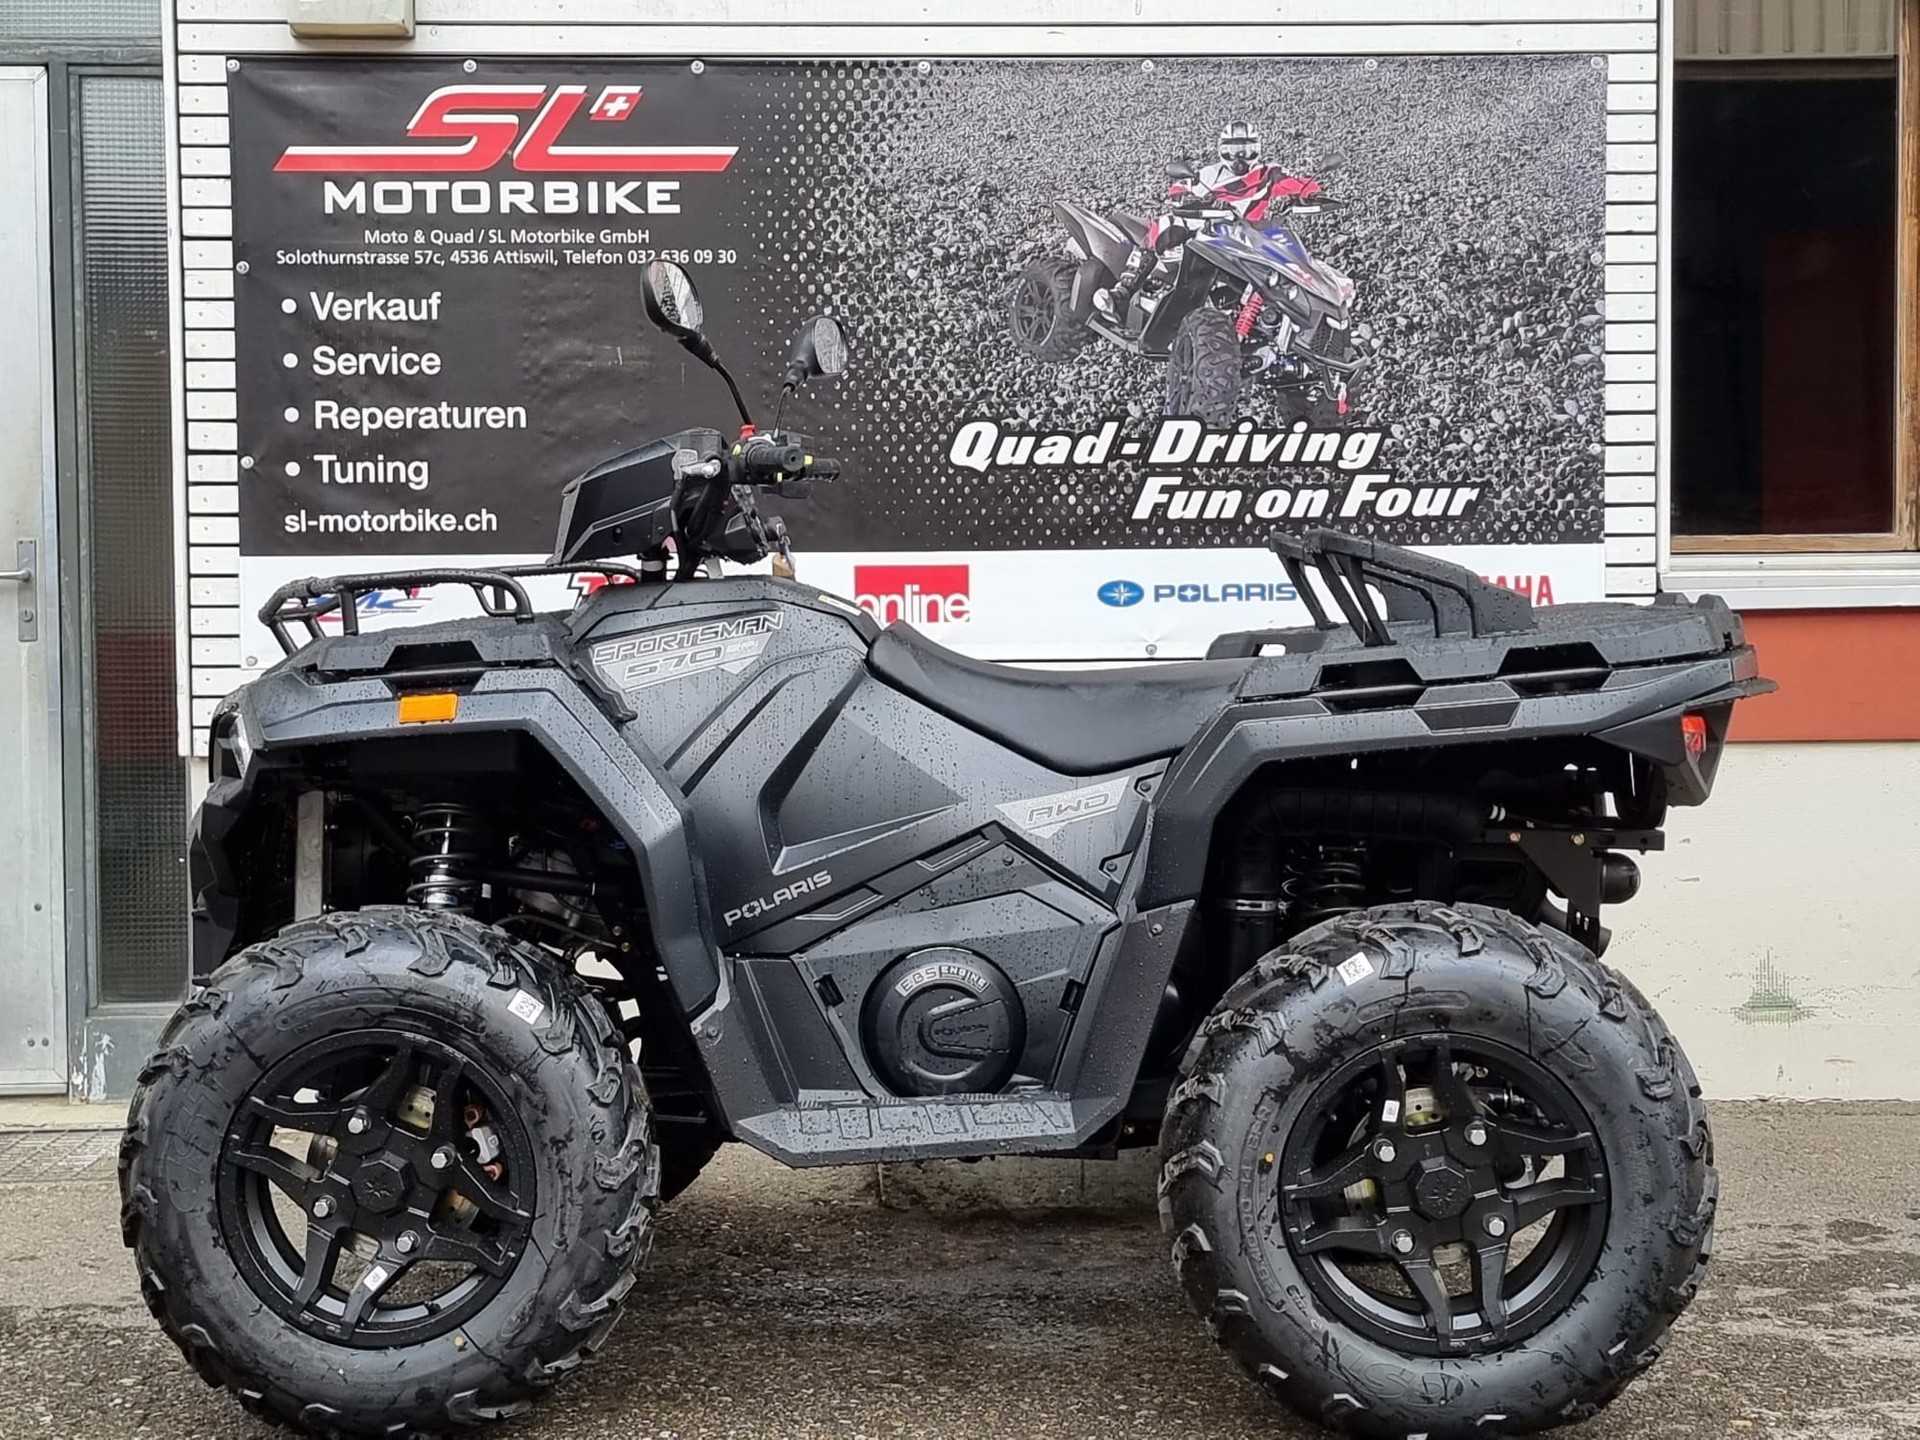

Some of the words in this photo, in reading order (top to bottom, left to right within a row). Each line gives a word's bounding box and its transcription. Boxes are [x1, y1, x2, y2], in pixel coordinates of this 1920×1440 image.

[323, 180, 681, 214] MOTORBIKE
[364, 229, 409, 244] Moto
[414, 229, 426, 244] &
[430, 228, 474, 246] Quad
[477, 228, 485, 245] /
[488, 228, 507, 244] SL
[510, 228, 596, 244] Motorbike
[599, 228, 650, 244] GmbH
[276, 249, 410, 265] Solothurnstrasse
[414, 249, 446, 267] 57c,
[449, 249, 489, 265] 4536
[492, 248, 559, 266] Attiswil,
[562, 248, 623, 265] Telefon
[627, 249, 656, 264] 032
[661, 249, 690, 264] 636
[693, 249, 714, 264] 09
[717, 249, 738, 264] 30
[309, 291, 442, 321] Verkauf
[312, 345, 441, 376] Service
[314, 400, 527, 437] Reperaturen
[949, 421, 1119, 473] Quad
[1147, 420, 1382, 469] Driving
[313, 454, 429, 491] Tuning
[1131, 477, 1243, 520] Fun
[1254, 488, 1330, 519] on
[1339, 474, 1480, 518] Four
[284, 508, 498, 533] sl-motorbike.ch
[855, 583, 970, 625] online
[1153, 583, 1299, 602] POLARIS
[594, 611, 785, 665] SPORTSMAN
[623, 644, 724, 681] 570
[1026, 792, 1110, 823] AWD
[723, 870, 832, 927] POLARIS
[900, 966, 938, 992] EBS
[940, 964, 987, 989] ENGINE
